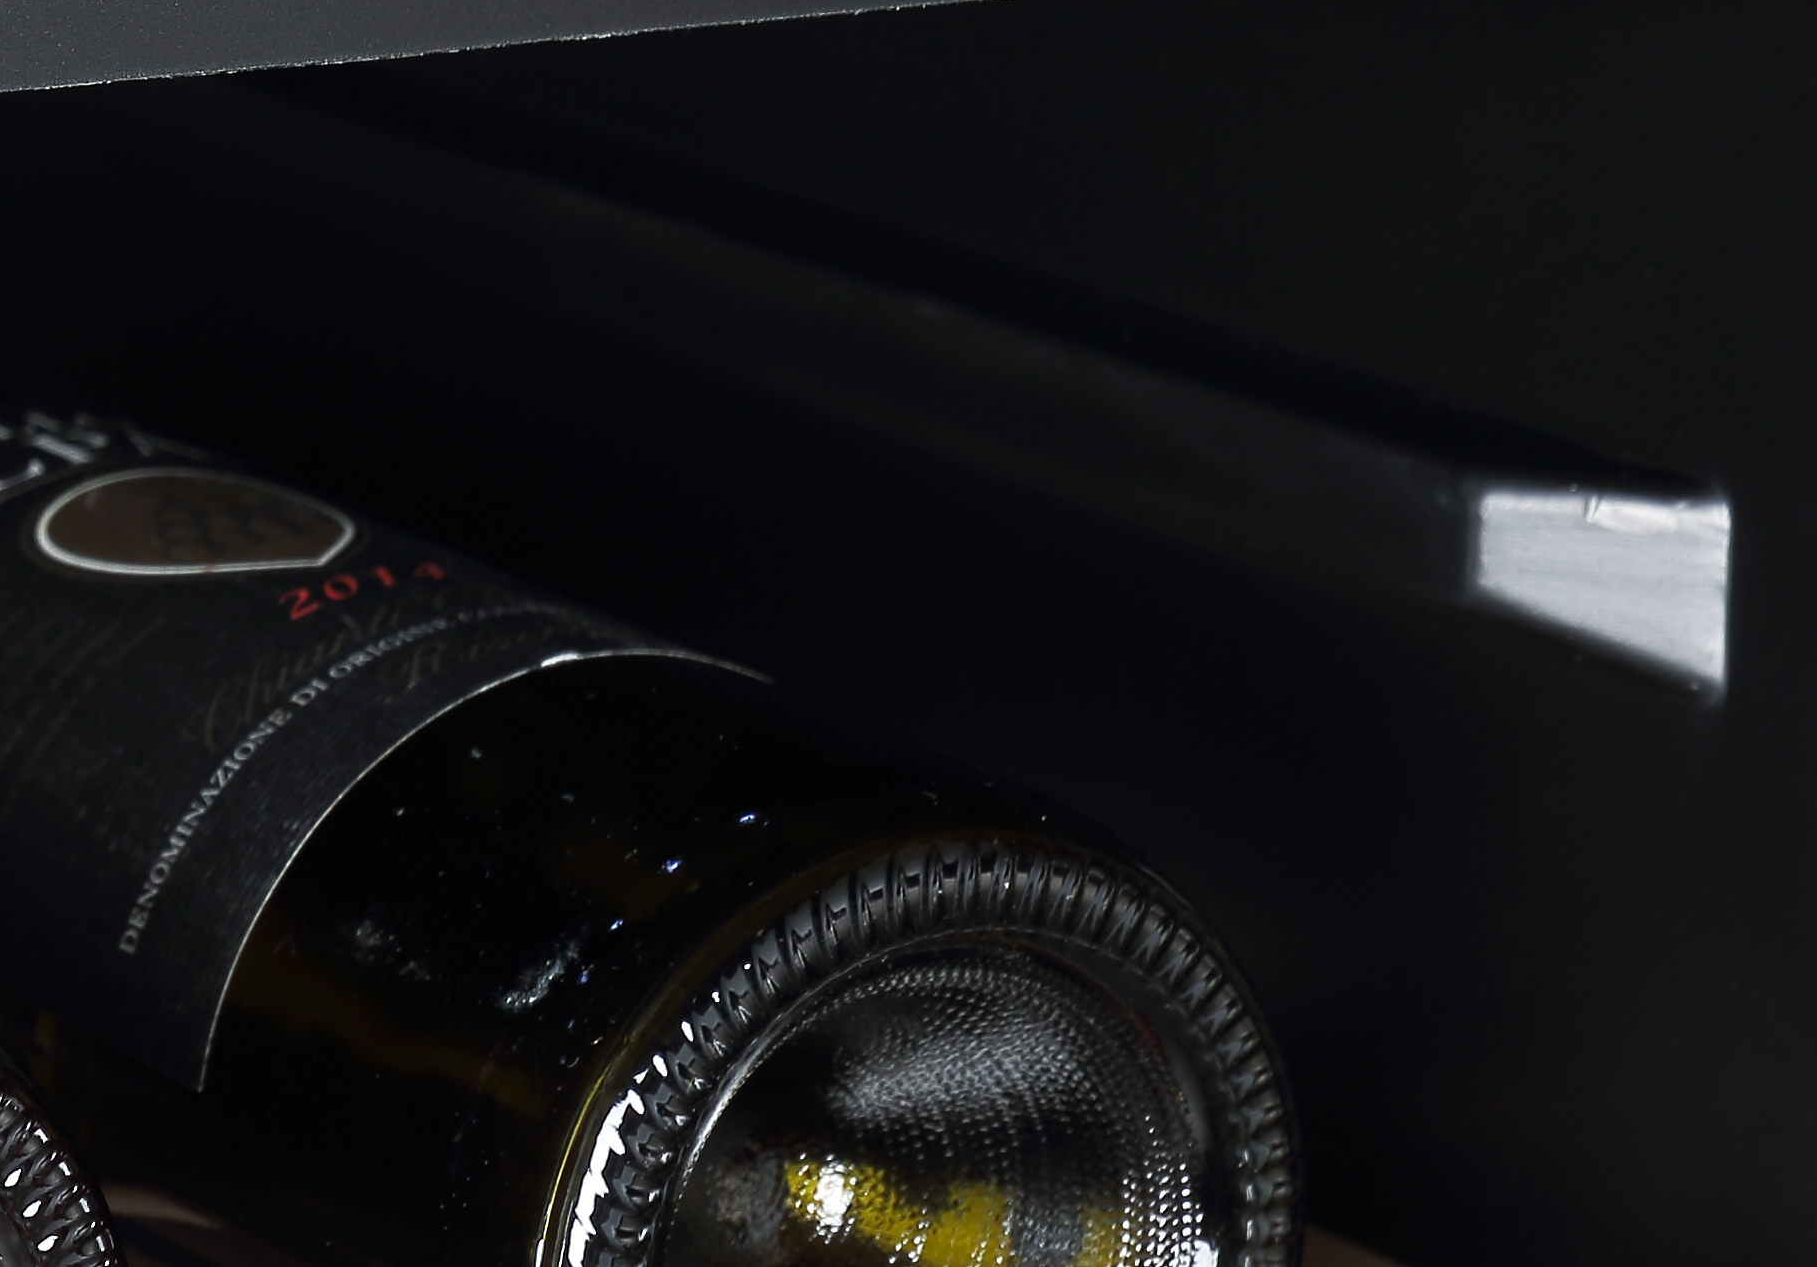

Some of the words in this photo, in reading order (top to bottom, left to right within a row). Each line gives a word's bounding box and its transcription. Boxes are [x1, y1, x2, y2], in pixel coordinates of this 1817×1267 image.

[277, 560, 445, 621] 2014
[118, 709, 294, 955] DENOMINAZIONE
[289, 678, 330, 708] DI
